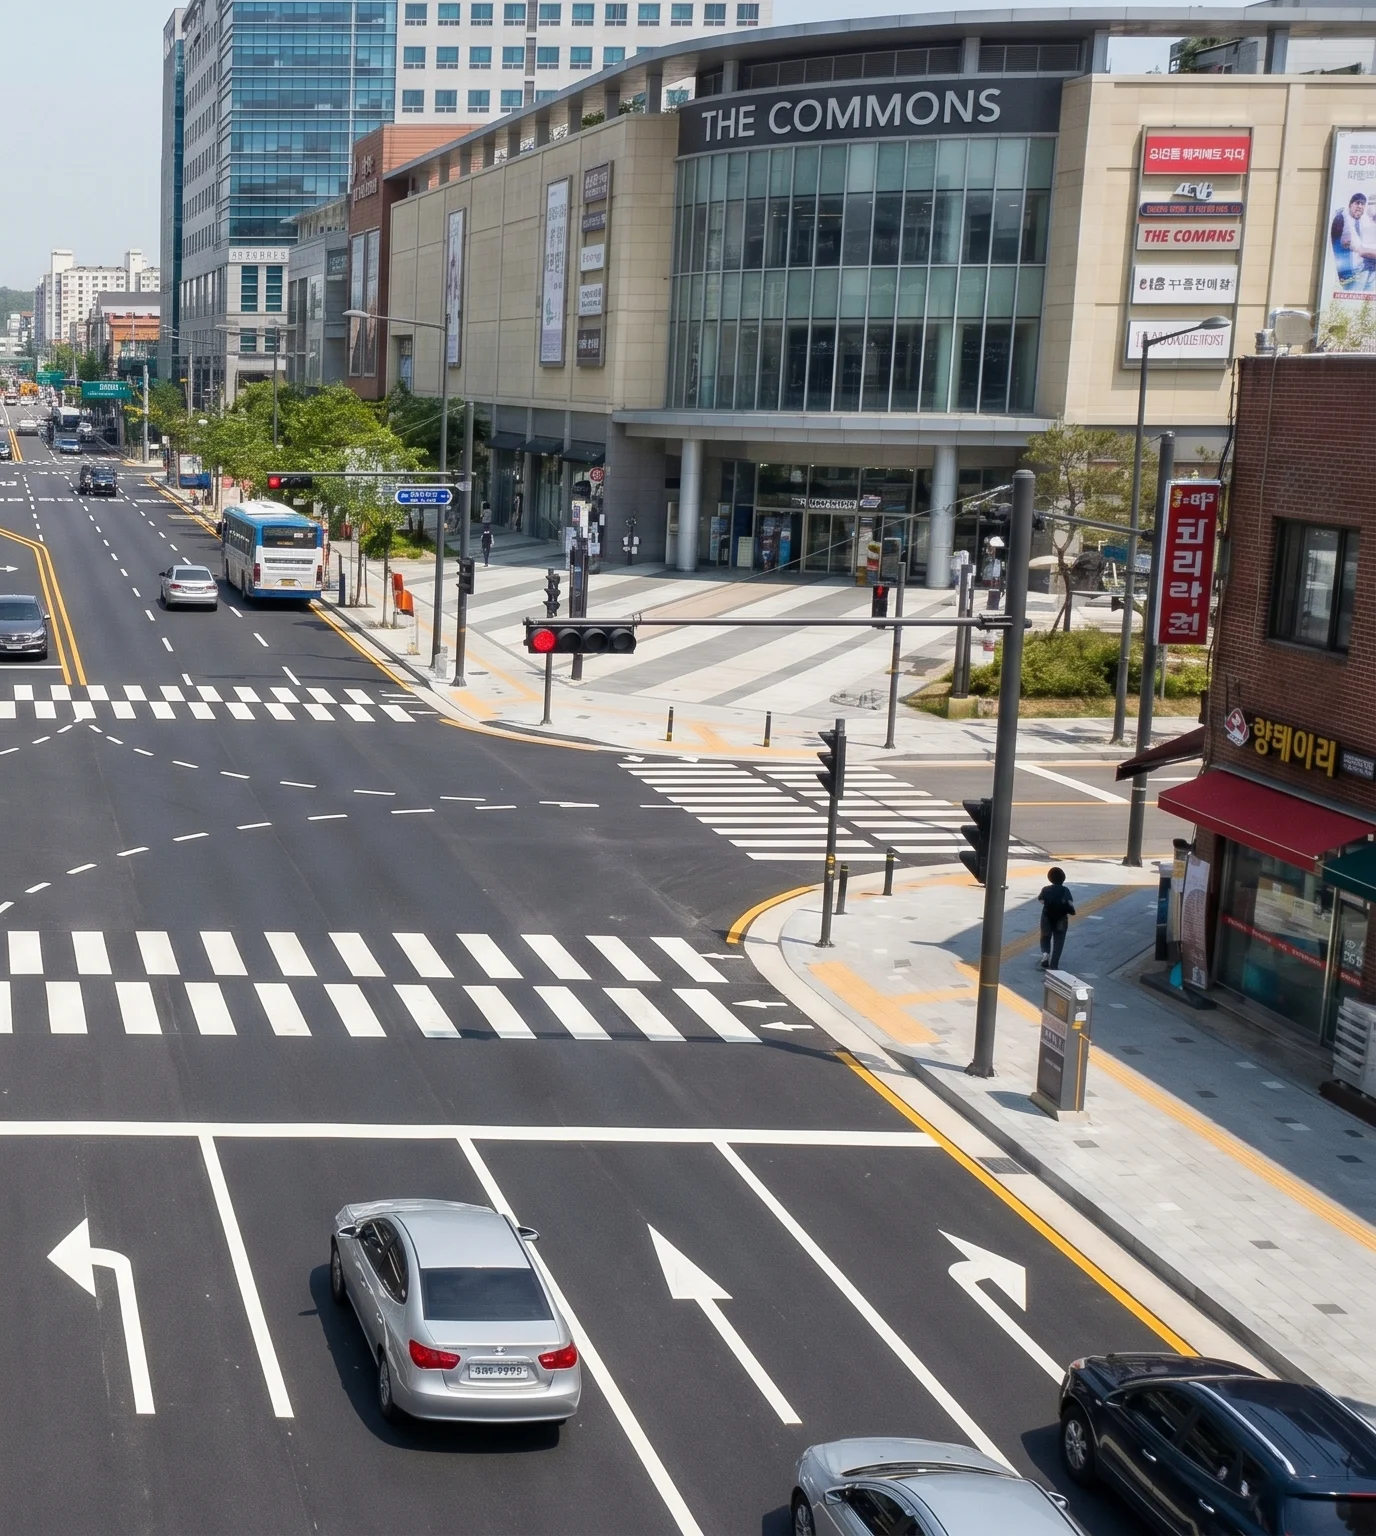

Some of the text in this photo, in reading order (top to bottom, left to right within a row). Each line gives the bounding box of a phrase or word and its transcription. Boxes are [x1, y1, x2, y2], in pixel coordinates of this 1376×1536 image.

[701, 88, 1002, 142] THE COMMONS
[1144, 229, 1171, 243] THE
